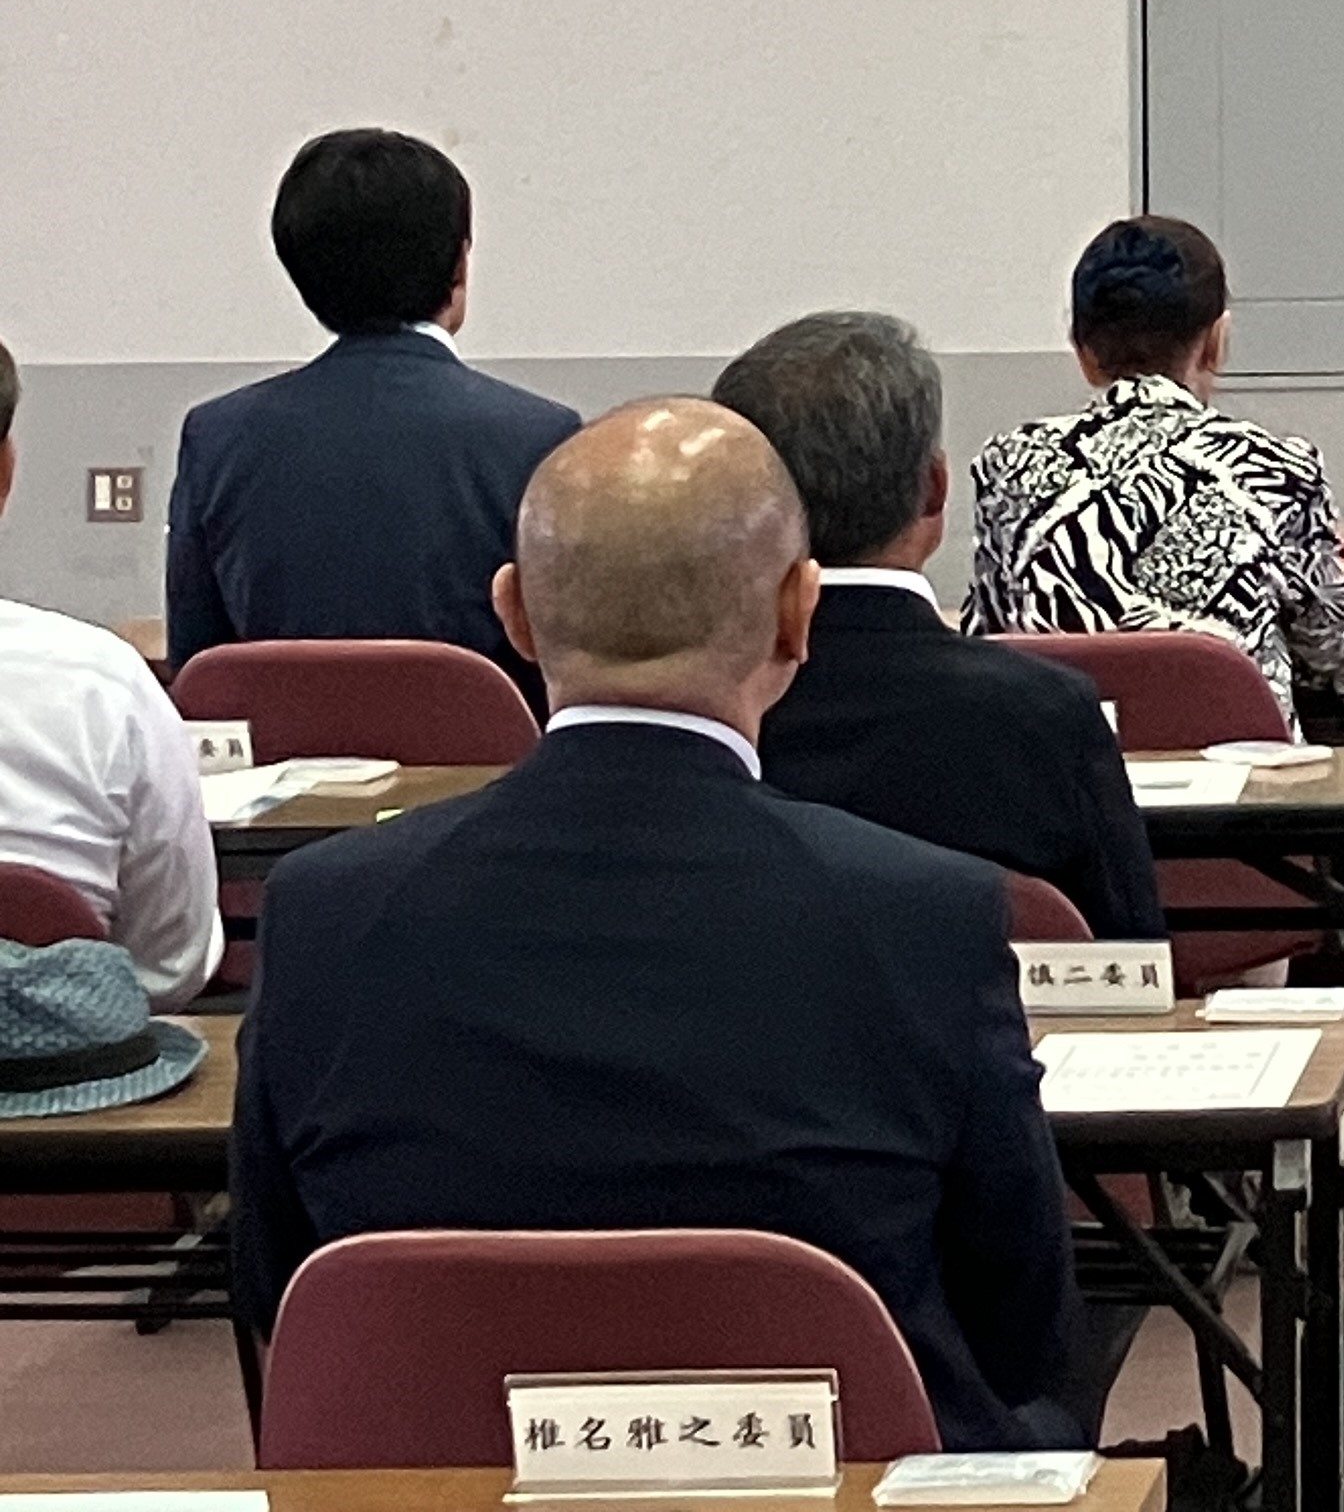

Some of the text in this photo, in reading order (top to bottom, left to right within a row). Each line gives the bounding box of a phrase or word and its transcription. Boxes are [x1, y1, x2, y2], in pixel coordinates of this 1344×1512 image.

[524, 1412, 816, 1451] 椎名雅之委員
